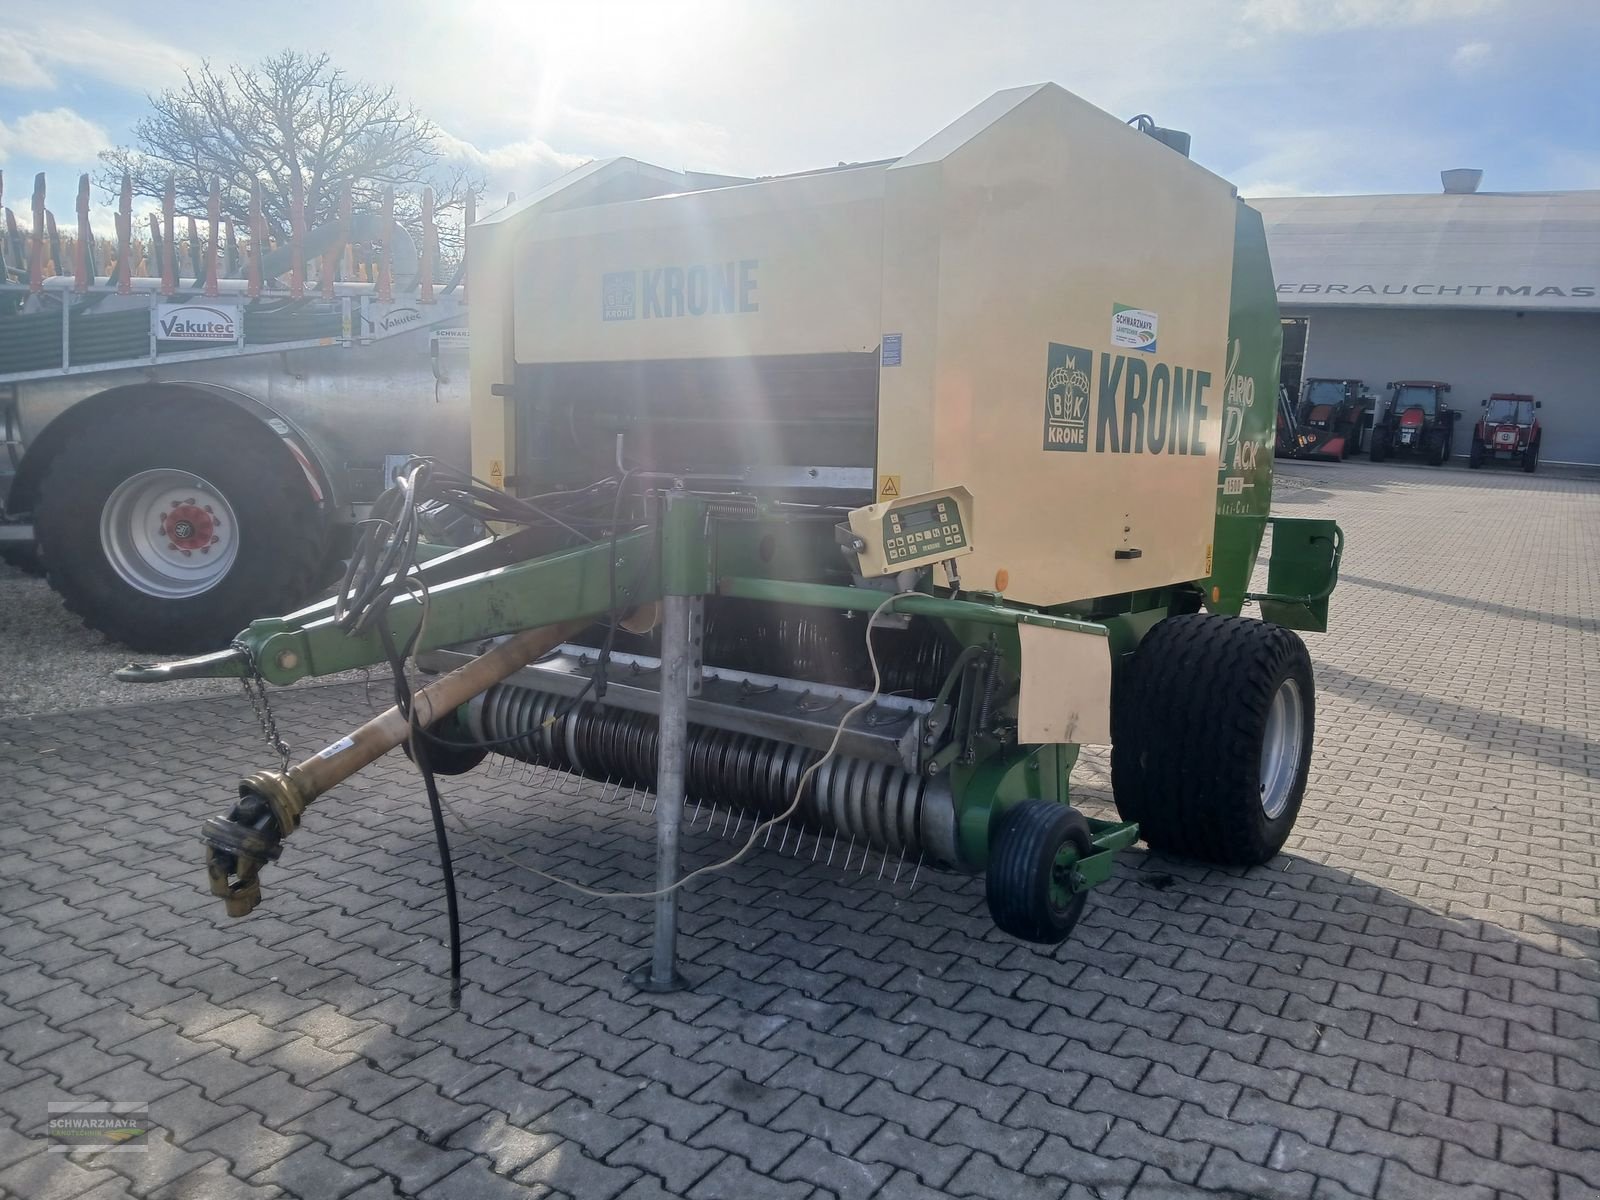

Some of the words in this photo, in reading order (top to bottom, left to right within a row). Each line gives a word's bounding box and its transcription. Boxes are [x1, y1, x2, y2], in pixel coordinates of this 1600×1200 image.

[642, 259, 759, 319] KRONE
[160, 315, 234, 337] Vakutec
[380, 312, 422, 331] Vakutec
[1065, 353, 1076, 370] M
[1053, 393, 1062, 416] B
[1073, 396, 1084, 418] K
[1096, 352, 1212, 456] KRONE
[1048, 426, 1084, 444] KRONE
